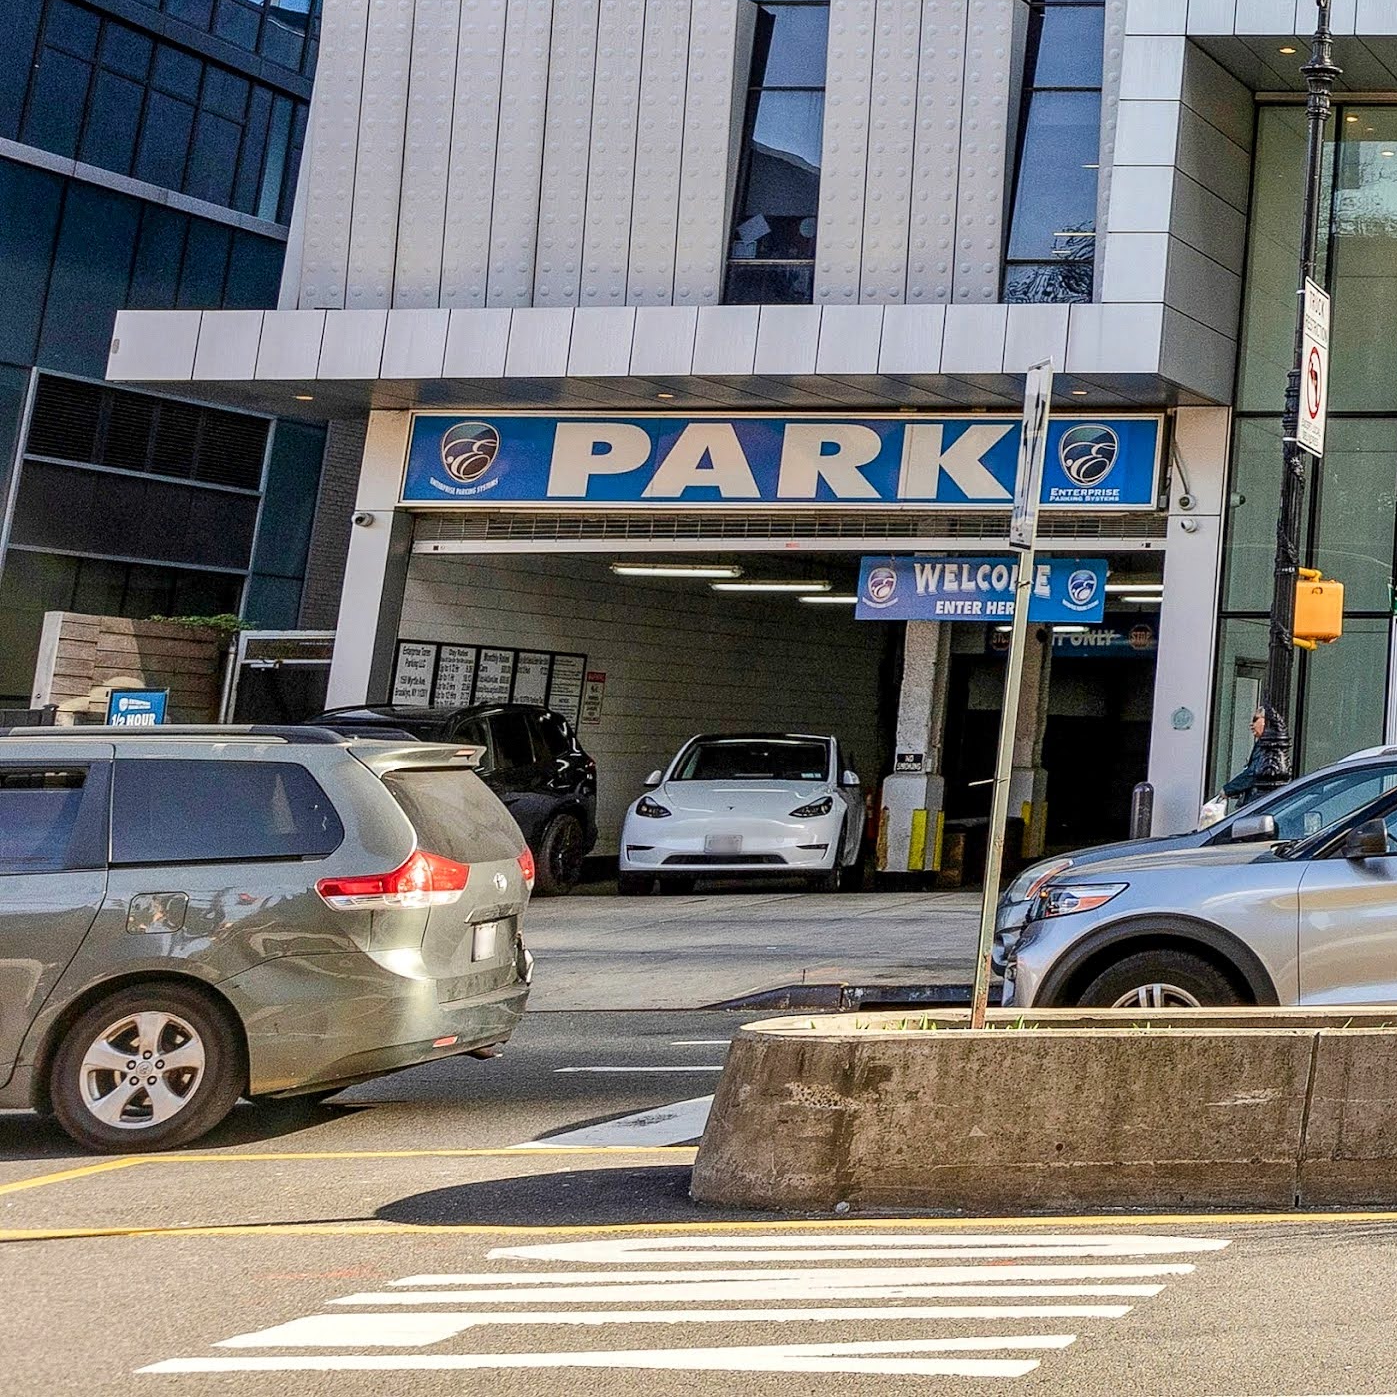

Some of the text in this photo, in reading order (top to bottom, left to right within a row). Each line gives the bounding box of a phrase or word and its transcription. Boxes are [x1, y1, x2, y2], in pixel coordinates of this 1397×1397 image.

[547, 422, 1014, 498] PARK
[1050, 487, 1120, 496] ENTERPRISE
[935, 601, 1016, 615] ENTER HER
[1070, 630, 1115, 646] ONLY
[126, 713, 156, 726] HOUR
